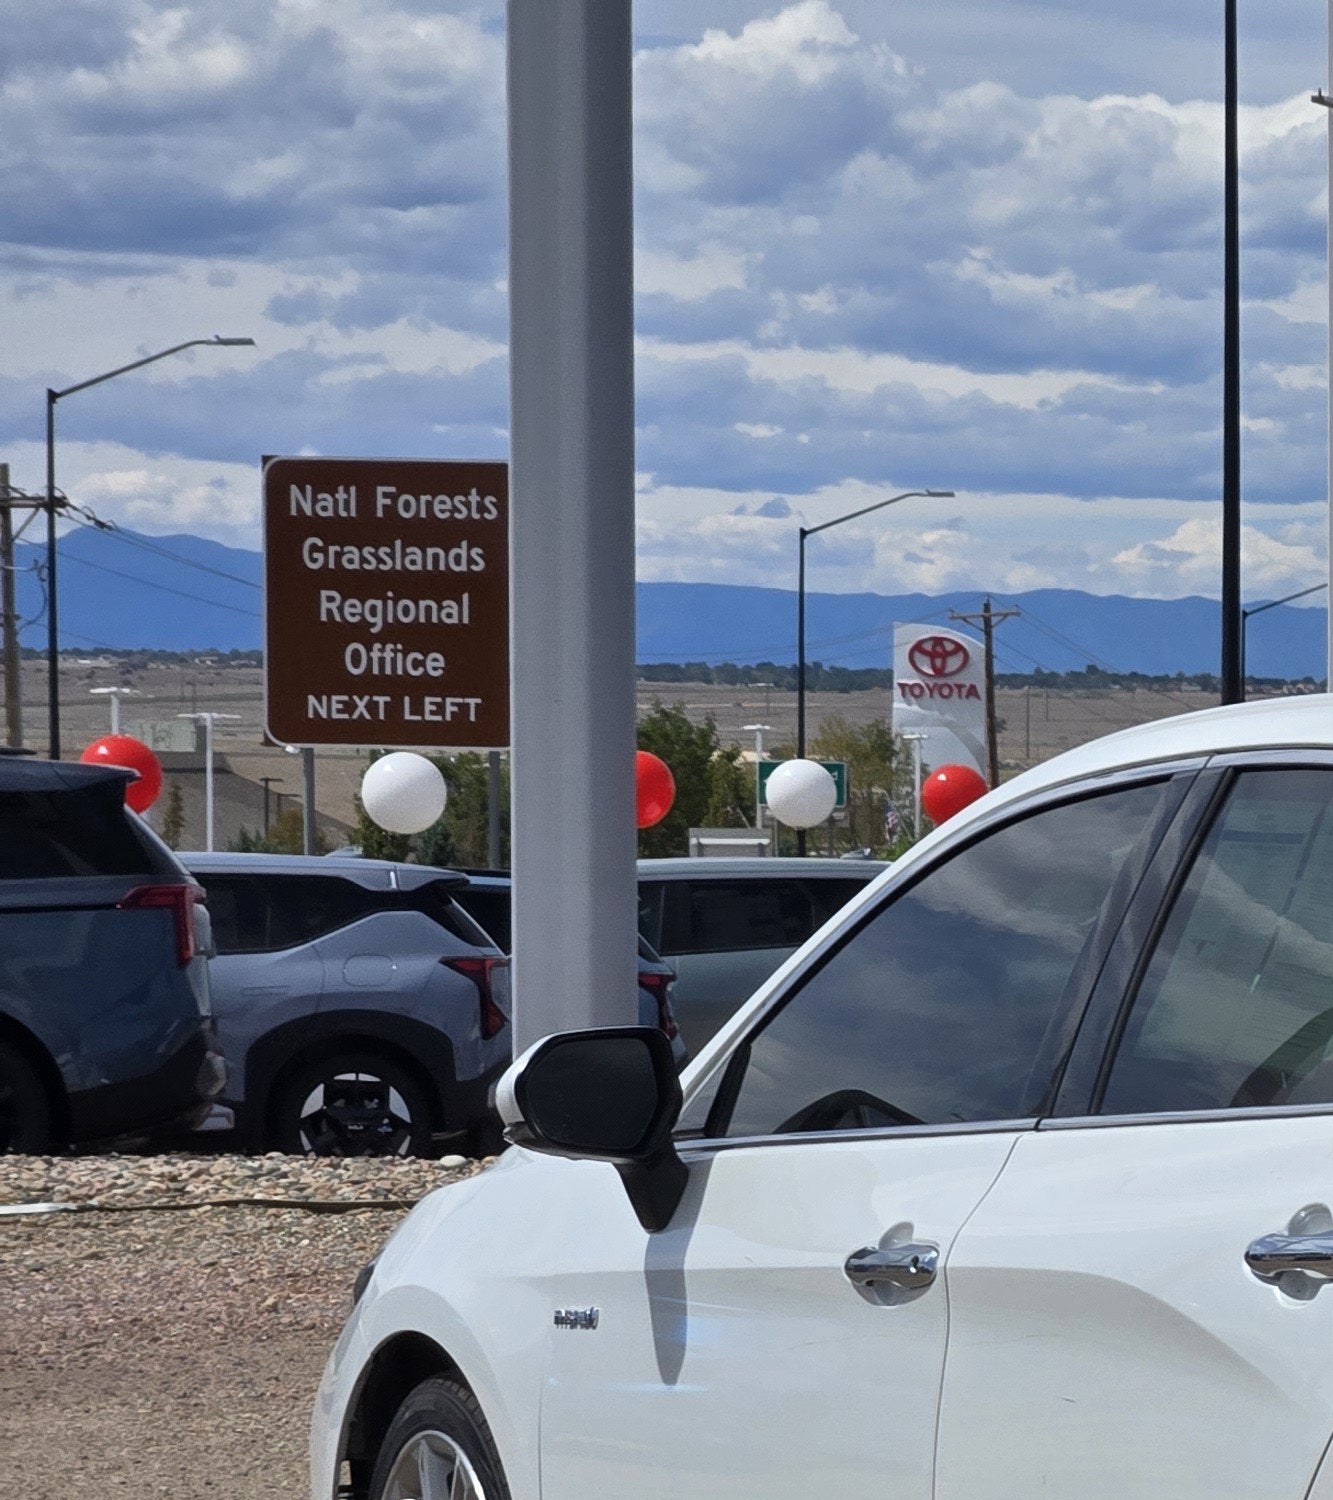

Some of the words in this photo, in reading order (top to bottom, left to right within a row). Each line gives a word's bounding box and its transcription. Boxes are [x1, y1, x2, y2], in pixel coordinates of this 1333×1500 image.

[290, 485, 356, 517] Natl
[376, 486, 498, 520] Forests
[302, 537, 486, 572] Grasslands
[320, 590, 469, 634] Regional
[344, 642, 445, 677] Office
[307, 695, 391, 720] NEXT
[403, 696, 482, 722] LEFT
[897, 682, 981, 701] TOYOTA
